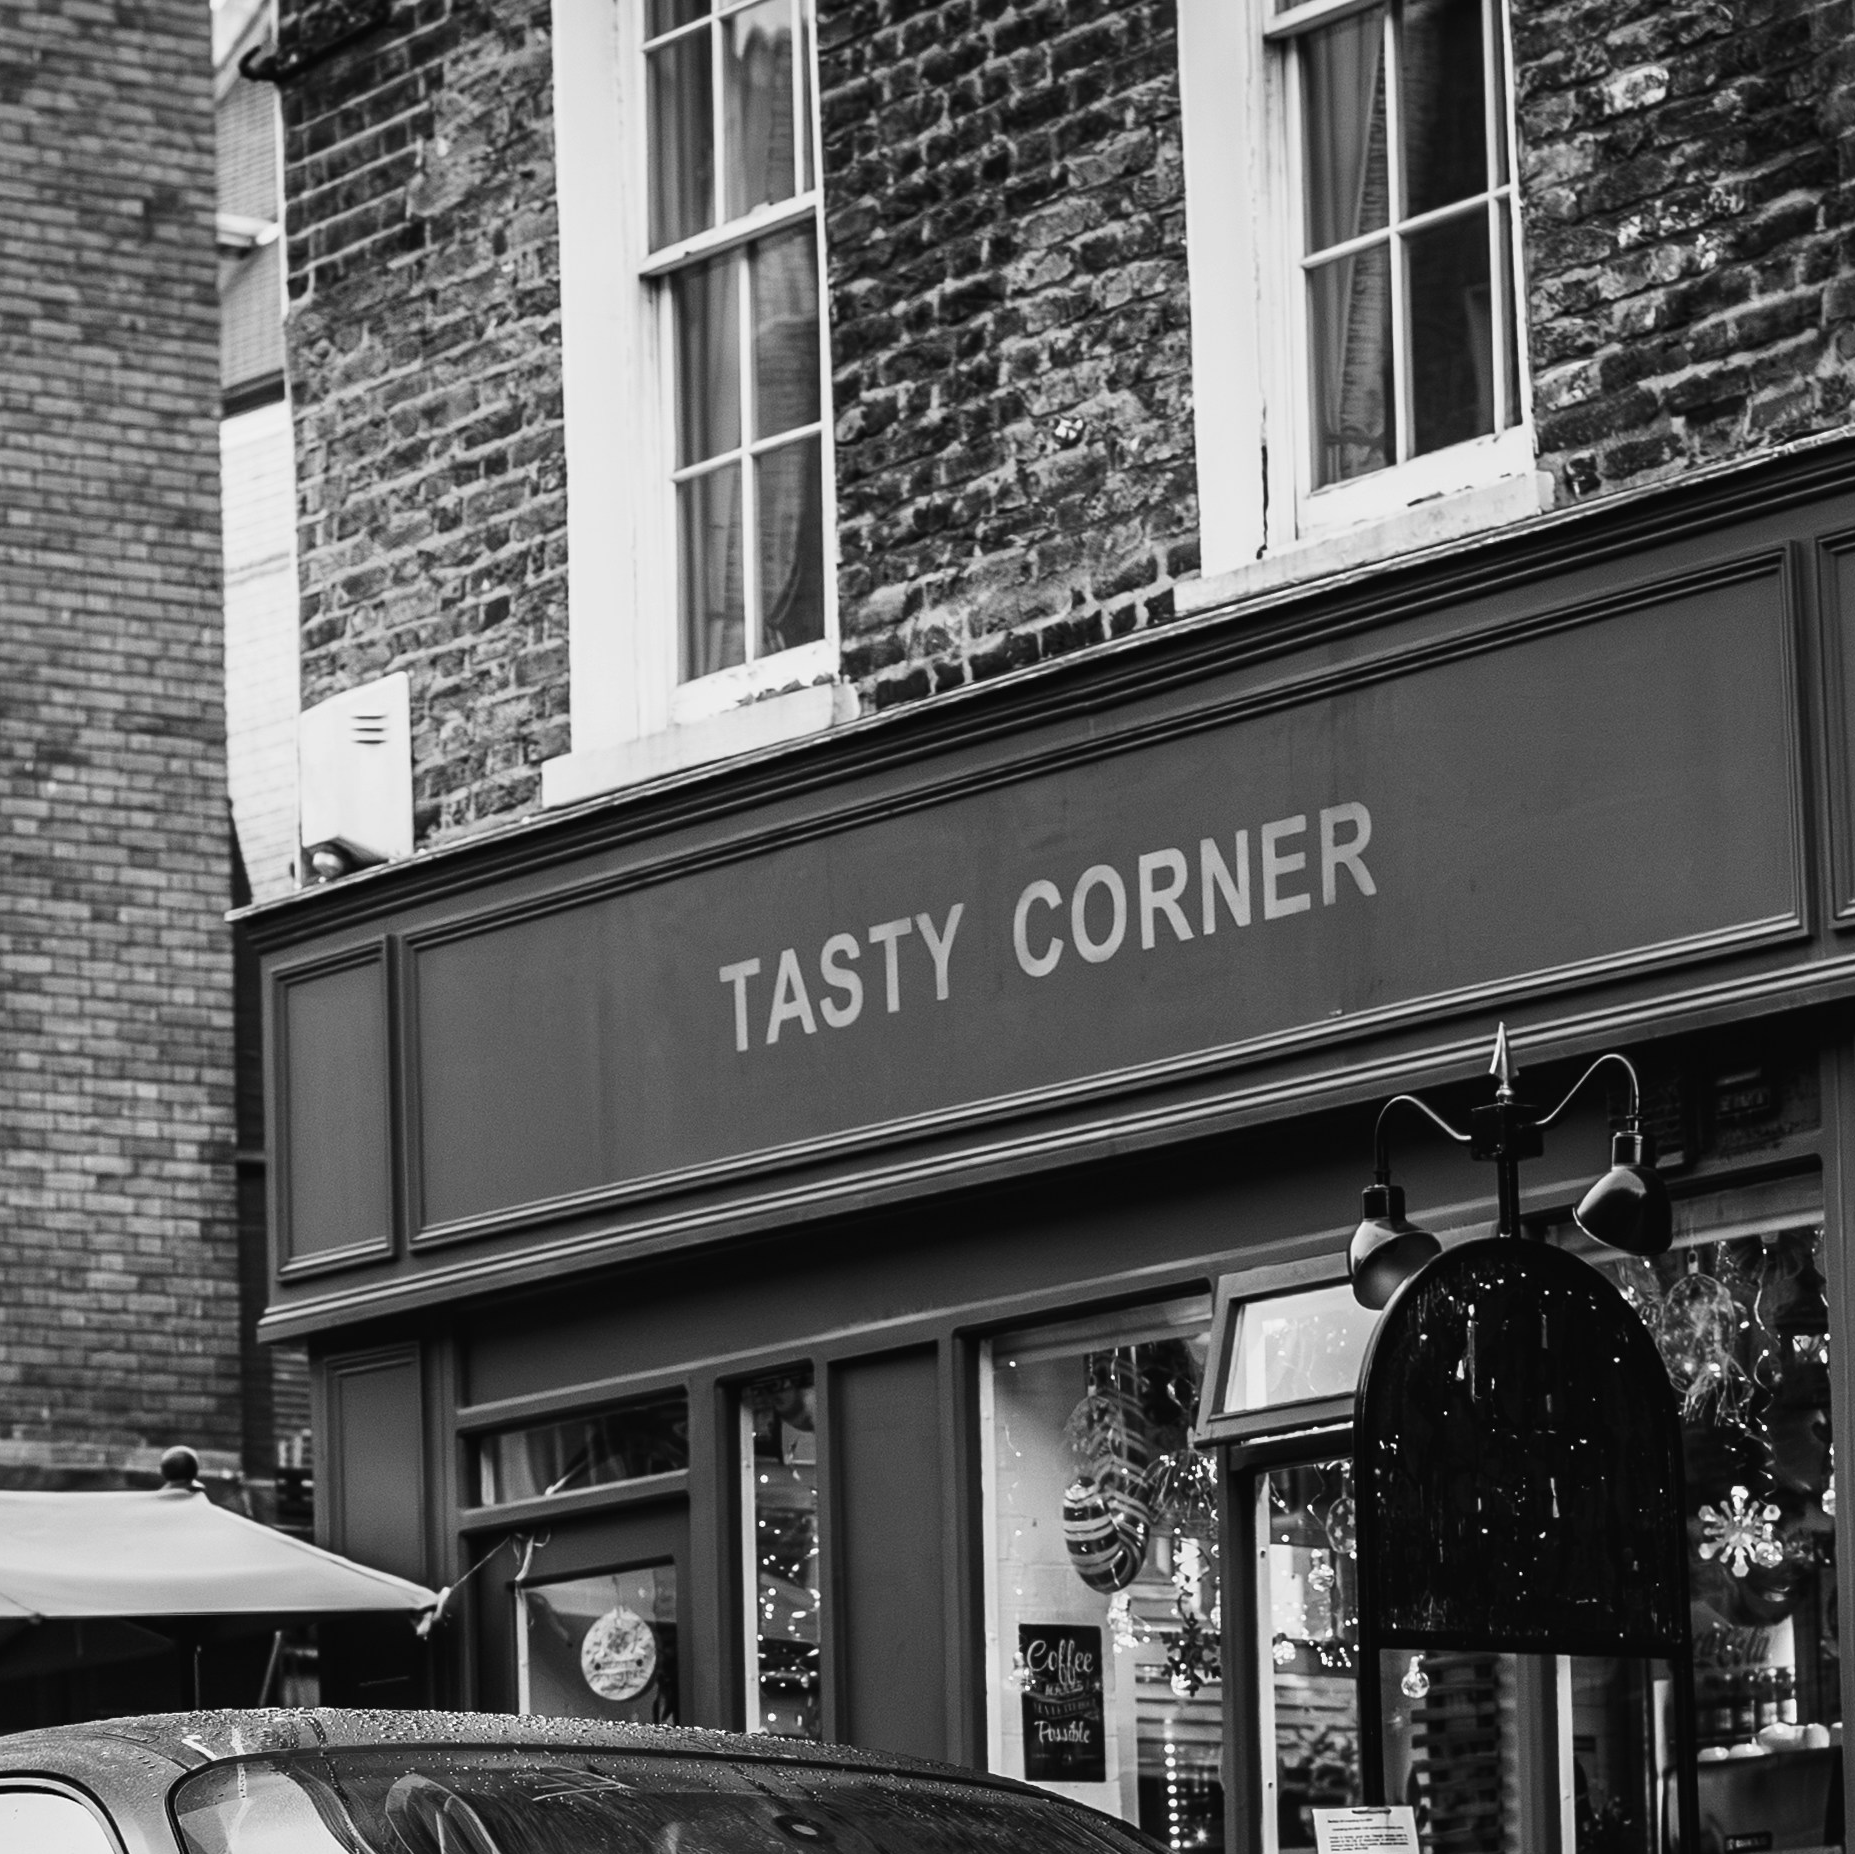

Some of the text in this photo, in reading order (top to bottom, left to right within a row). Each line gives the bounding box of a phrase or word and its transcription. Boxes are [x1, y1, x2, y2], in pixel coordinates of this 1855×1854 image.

[718, 801, 1378, 1053] TASTY CORNER
[1026, 1638, 1095, 1686] Coffee
